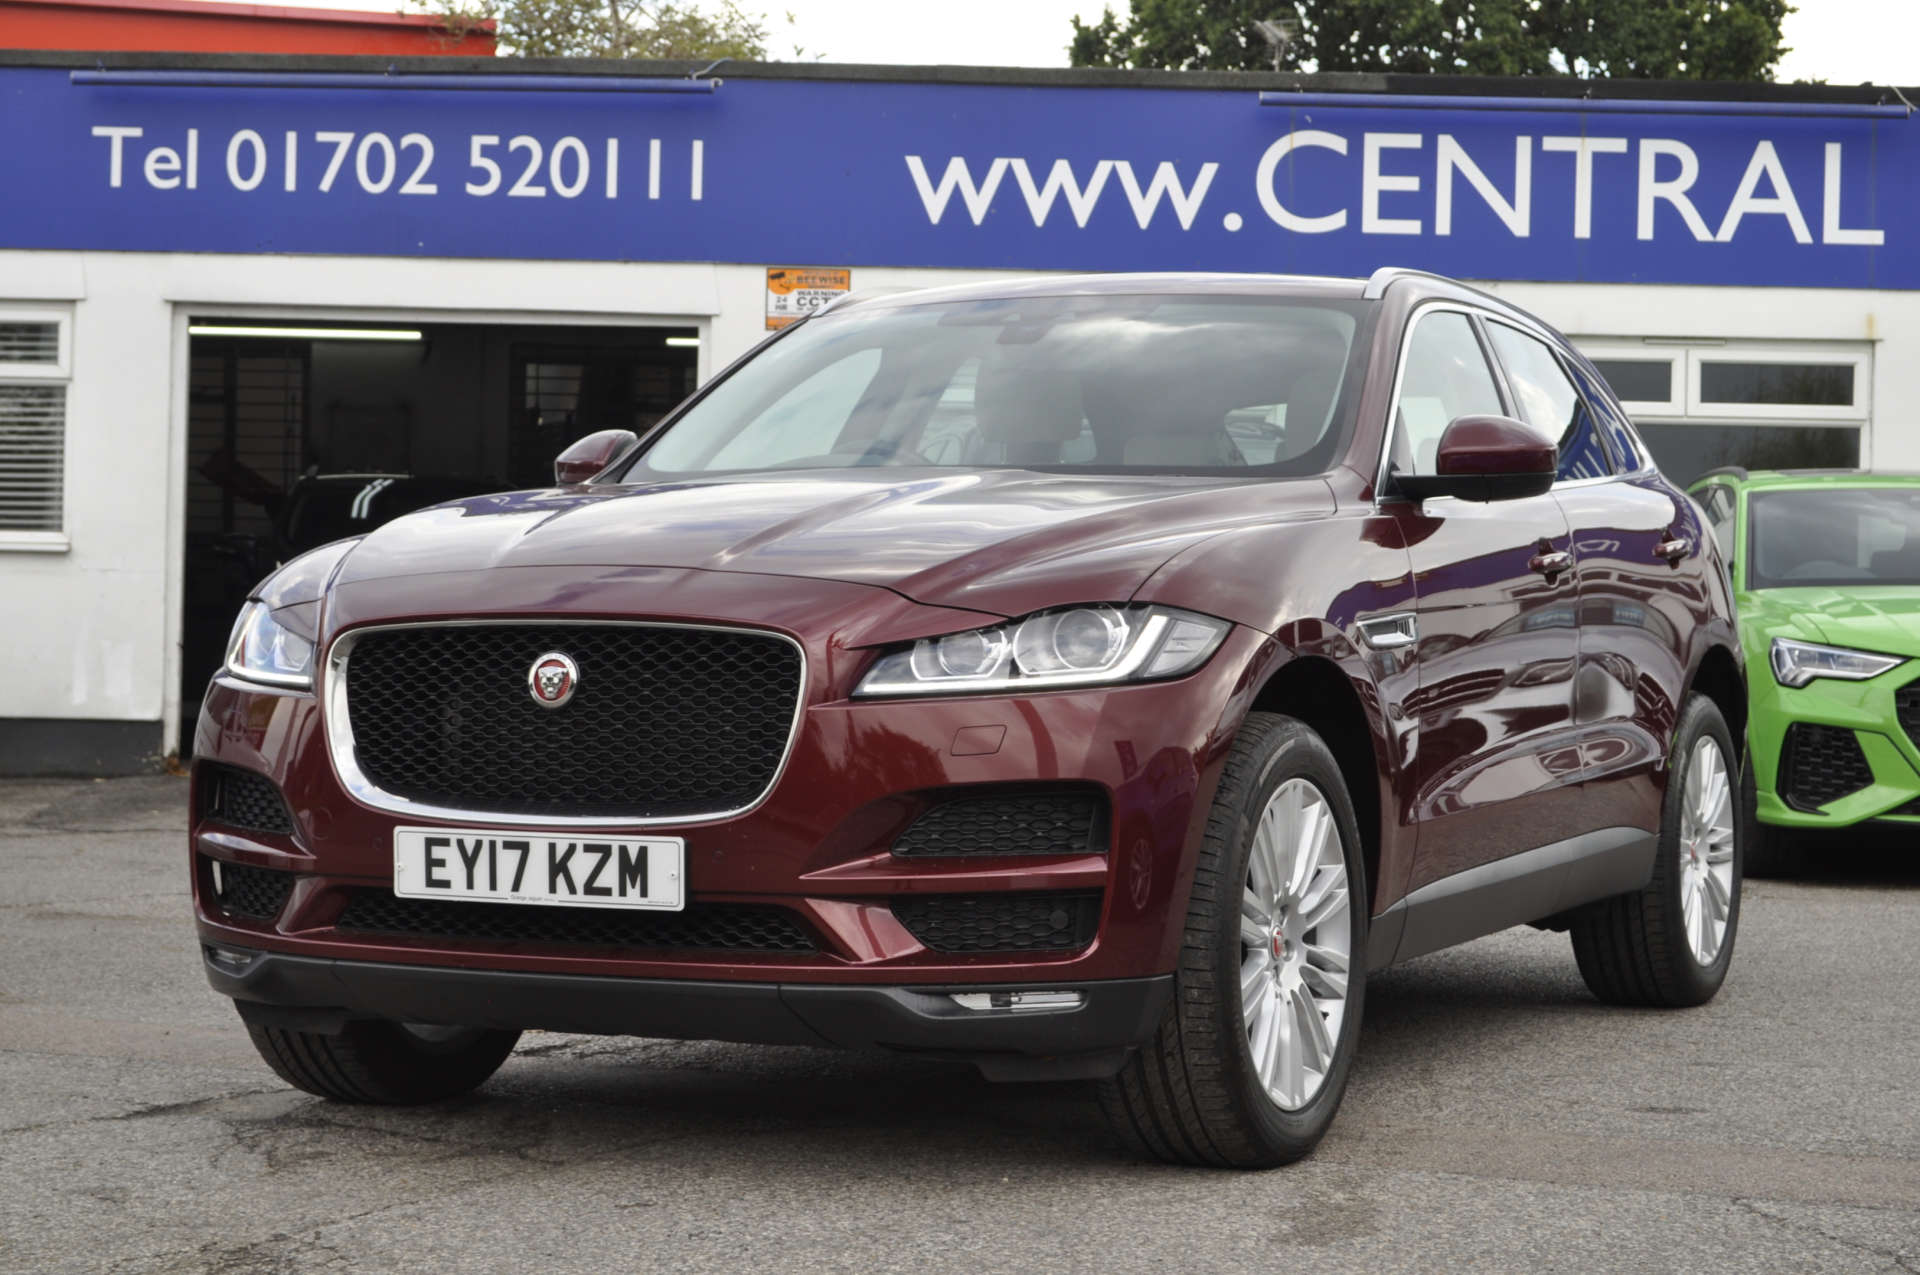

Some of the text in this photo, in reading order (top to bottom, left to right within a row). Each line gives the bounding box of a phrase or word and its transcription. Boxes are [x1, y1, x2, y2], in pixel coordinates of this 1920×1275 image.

[91, 126, 705, 202] Tel 01702 520111
[796, 296, 832, 307] CCT
[424, 836, 650, 899] EY17 KZM
